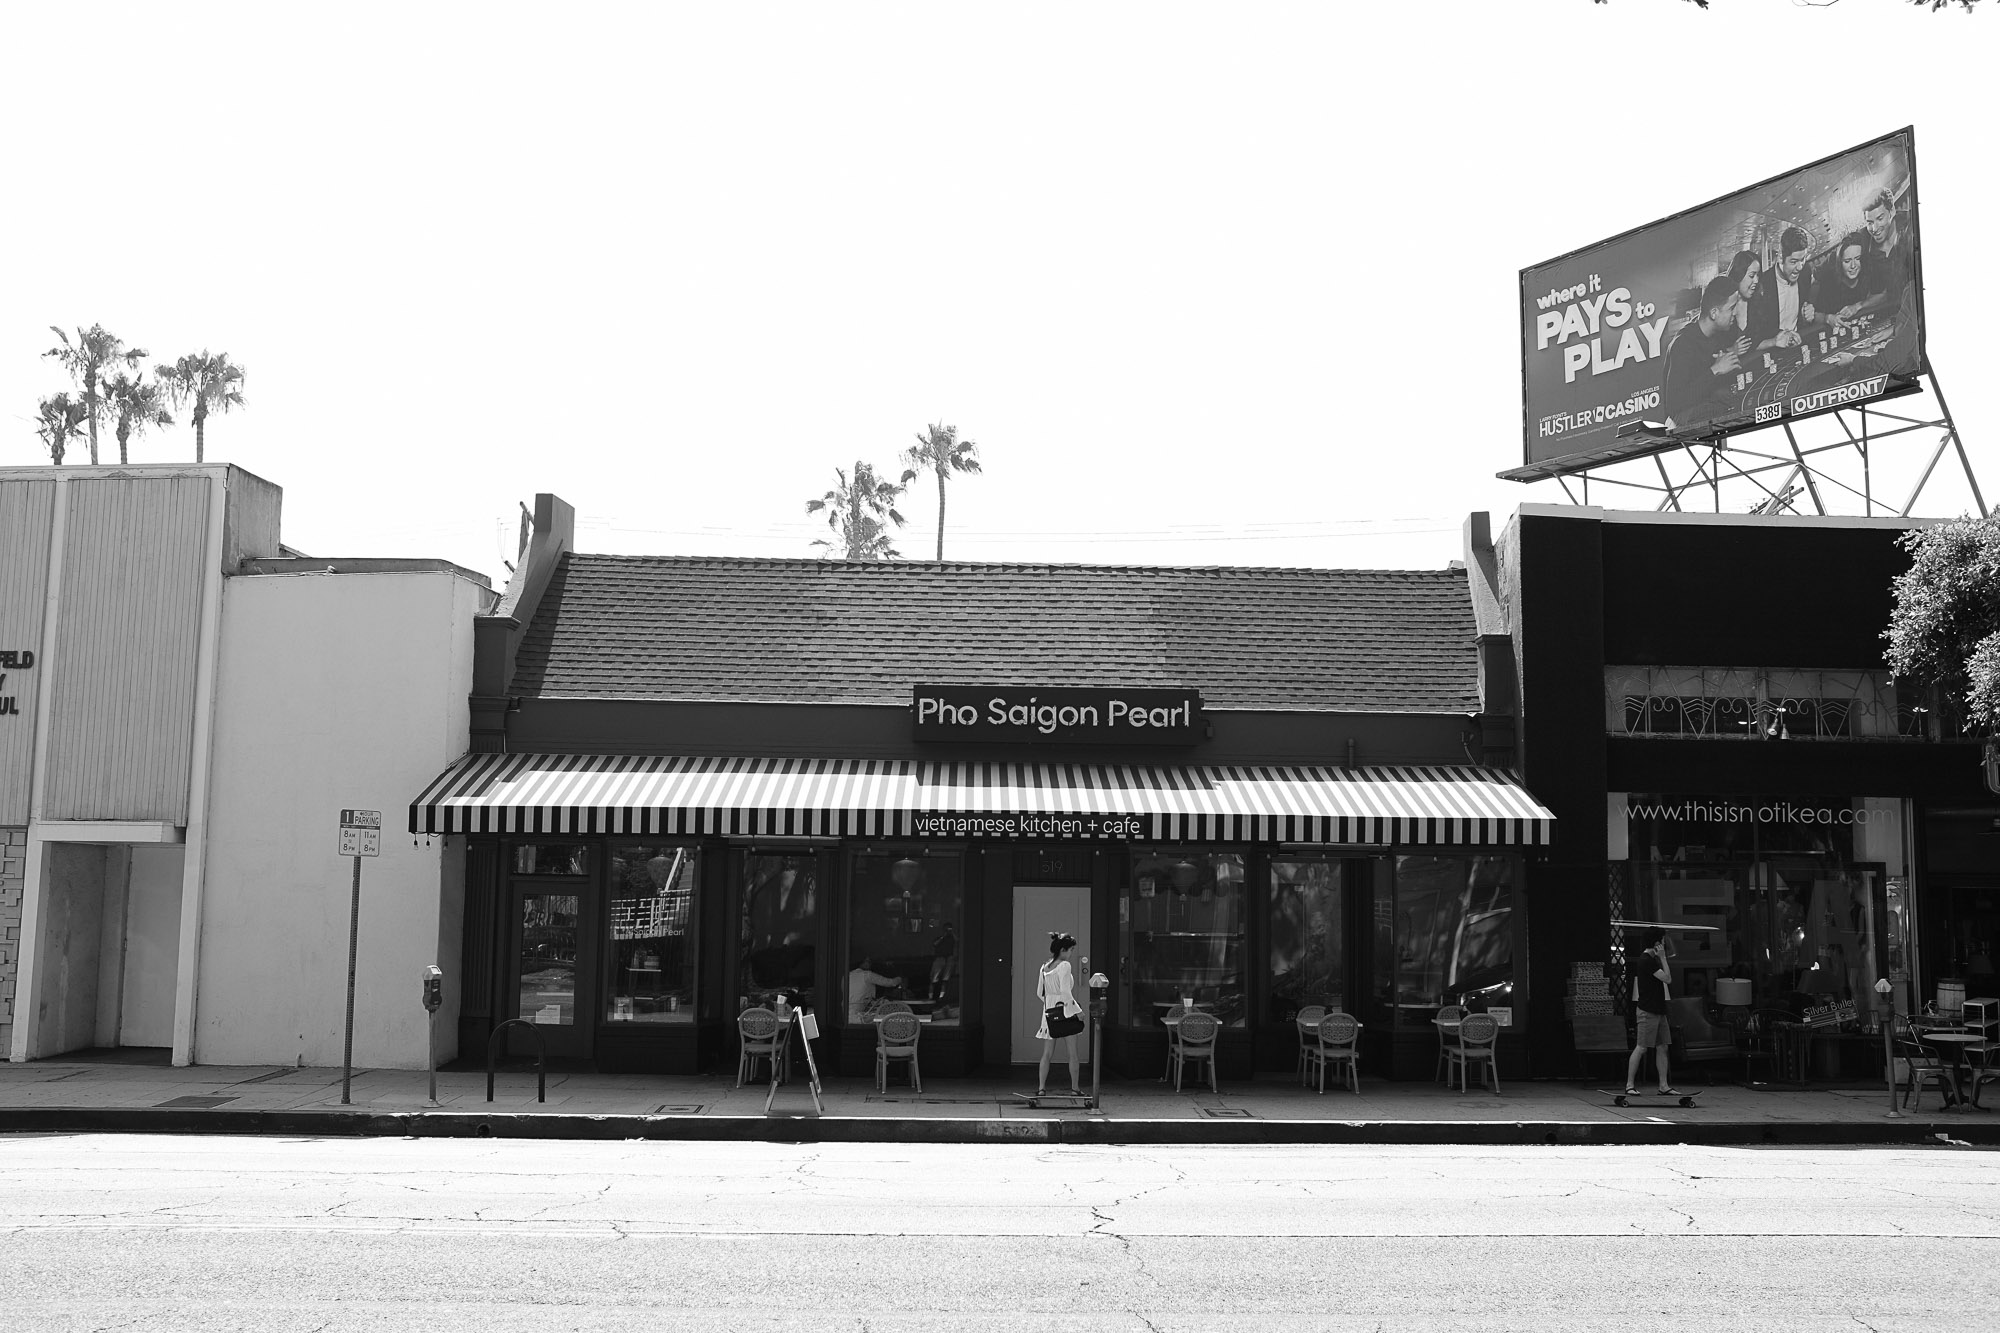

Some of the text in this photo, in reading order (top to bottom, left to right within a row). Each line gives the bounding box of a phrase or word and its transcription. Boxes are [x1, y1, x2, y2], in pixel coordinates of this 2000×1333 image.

[1537, 274, 1602, 309] where it
[1537, 287, 1656, 350] PAYS to
[1564, 315, 1670, 384] PLAY
[1605, 392, 1660, 420] CASINO
[1794, 378, 1883, 412] OUTFRONT
[1539, 410, 1592, 438] HUSTLER
[1756, 403, 1780, 422] 5389
[918, 696, 1190, 733] Pho Saigon Pearl
[355, 816, 379, 825] PARKING
[915, 815, 1015, 832] vietnamese
[1020, 816, 1082, 833] kitchen
[1103, 817, 1140, 834] cafe
[1041, 860, 1064, 873] 519
[663, 928, 685, 937] Pearl
[1803, 998, 1857, 1018] Silver Bullet
